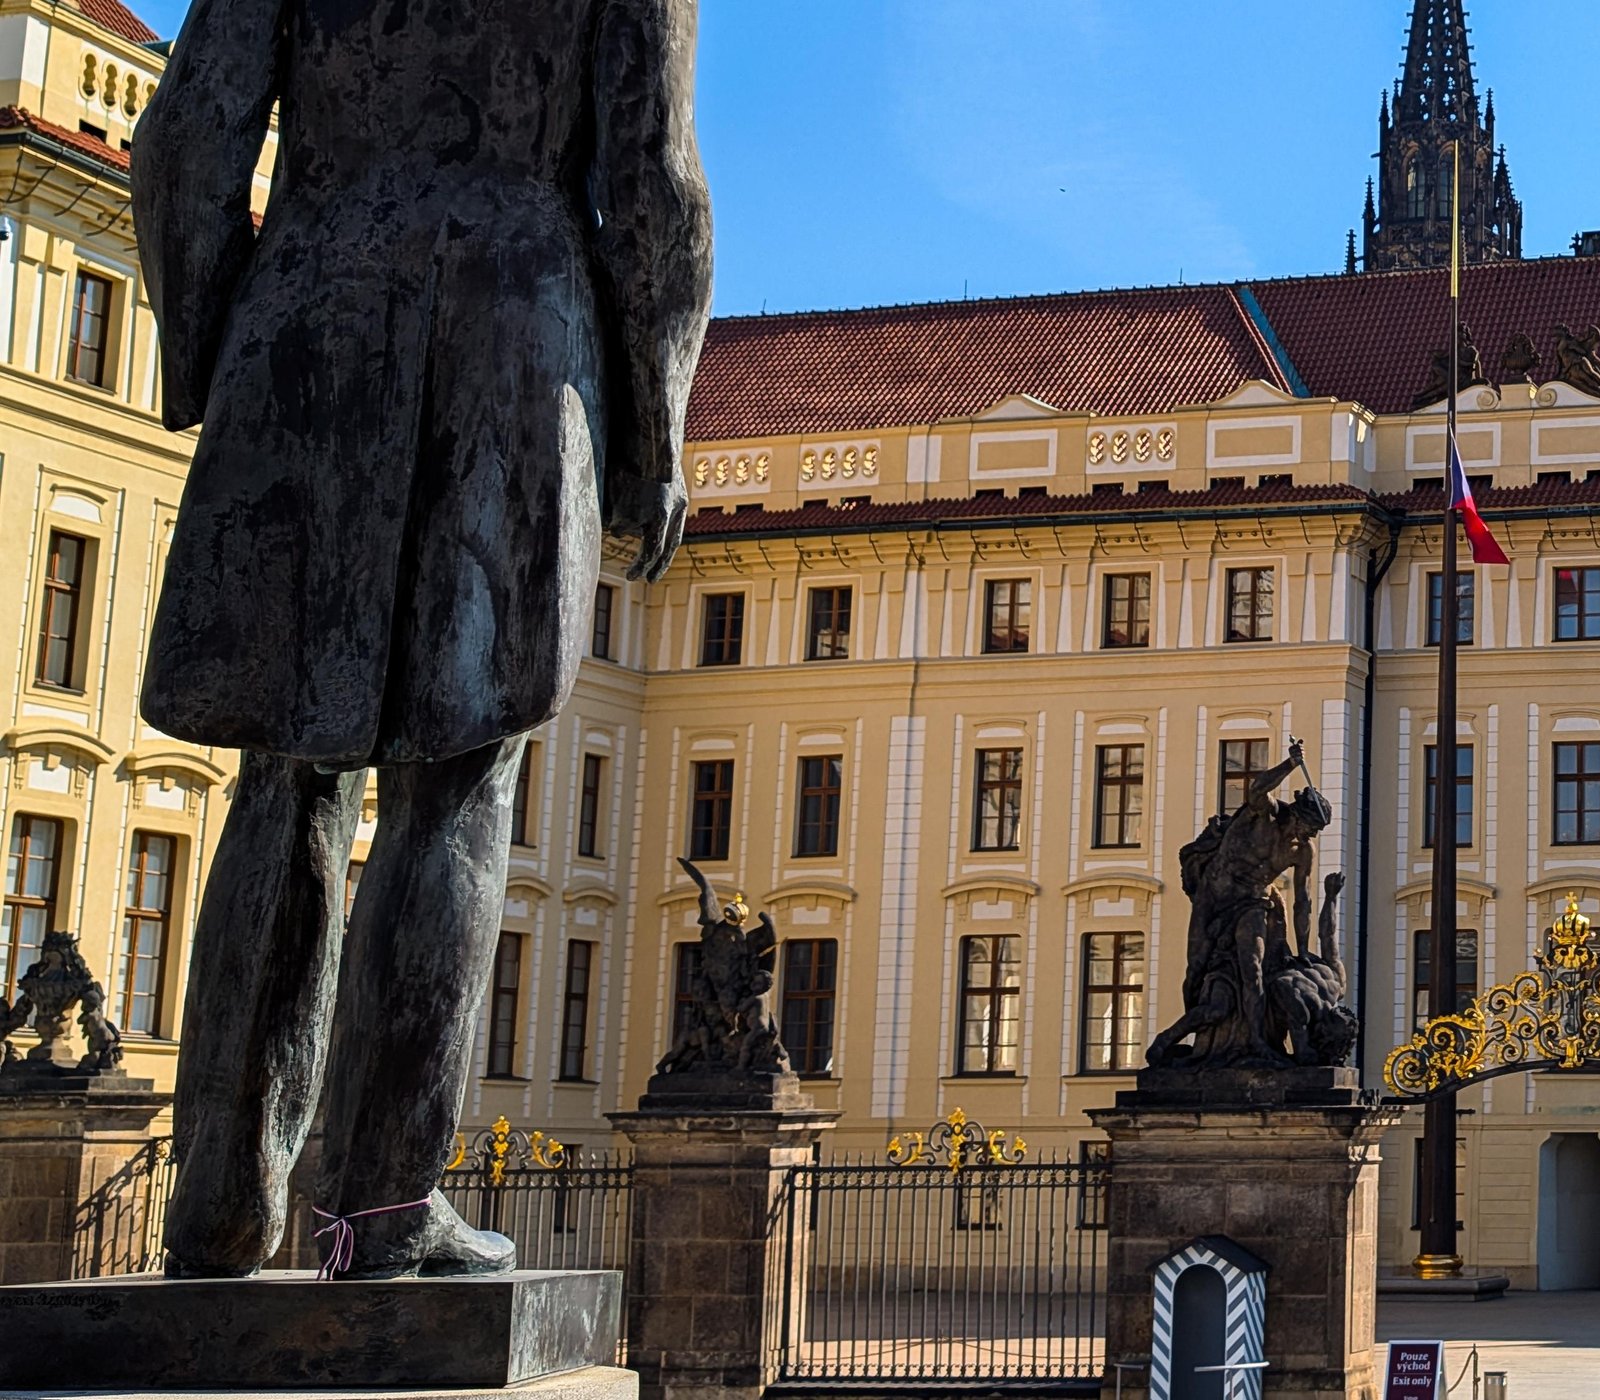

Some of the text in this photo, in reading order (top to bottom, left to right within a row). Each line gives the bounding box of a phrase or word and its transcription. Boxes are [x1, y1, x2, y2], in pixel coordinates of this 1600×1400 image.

[1400, 1352, 1429, 1361] Pouze
[1396, 1361, 1431, 1372] východ
[1392, 1376, 1432, 1387] Exit only
